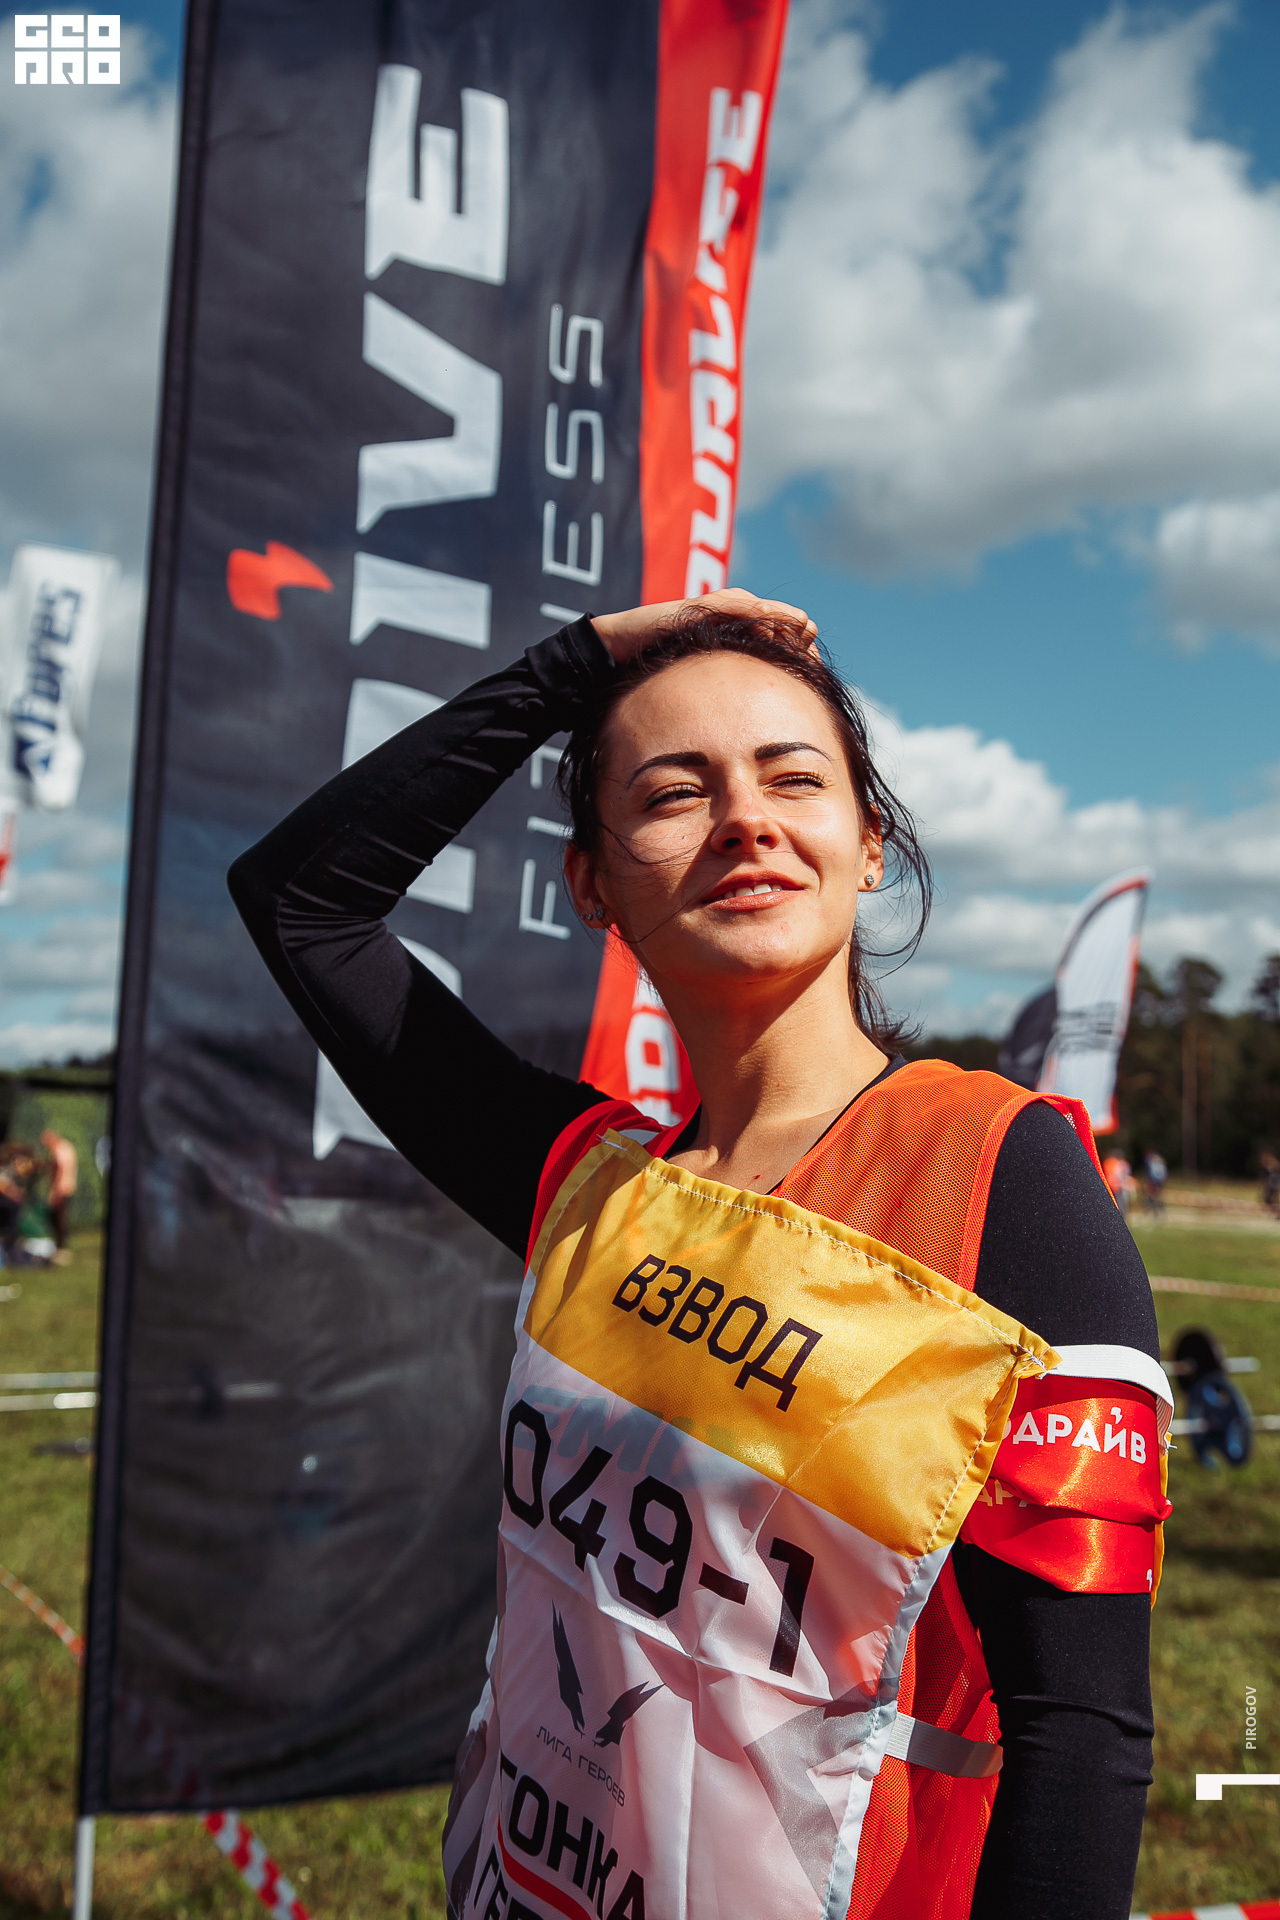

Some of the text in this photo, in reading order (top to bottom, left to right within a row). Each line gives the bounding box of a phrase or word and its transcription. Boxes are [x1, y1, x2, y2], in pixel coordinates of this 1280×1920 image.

[612, 1254, 823, 1412] ВЗВОД
[503, 1399, 815, 1678] 049-1
[536, 1725, 626, 1807] ЛИГА ГЕРОЕВ
